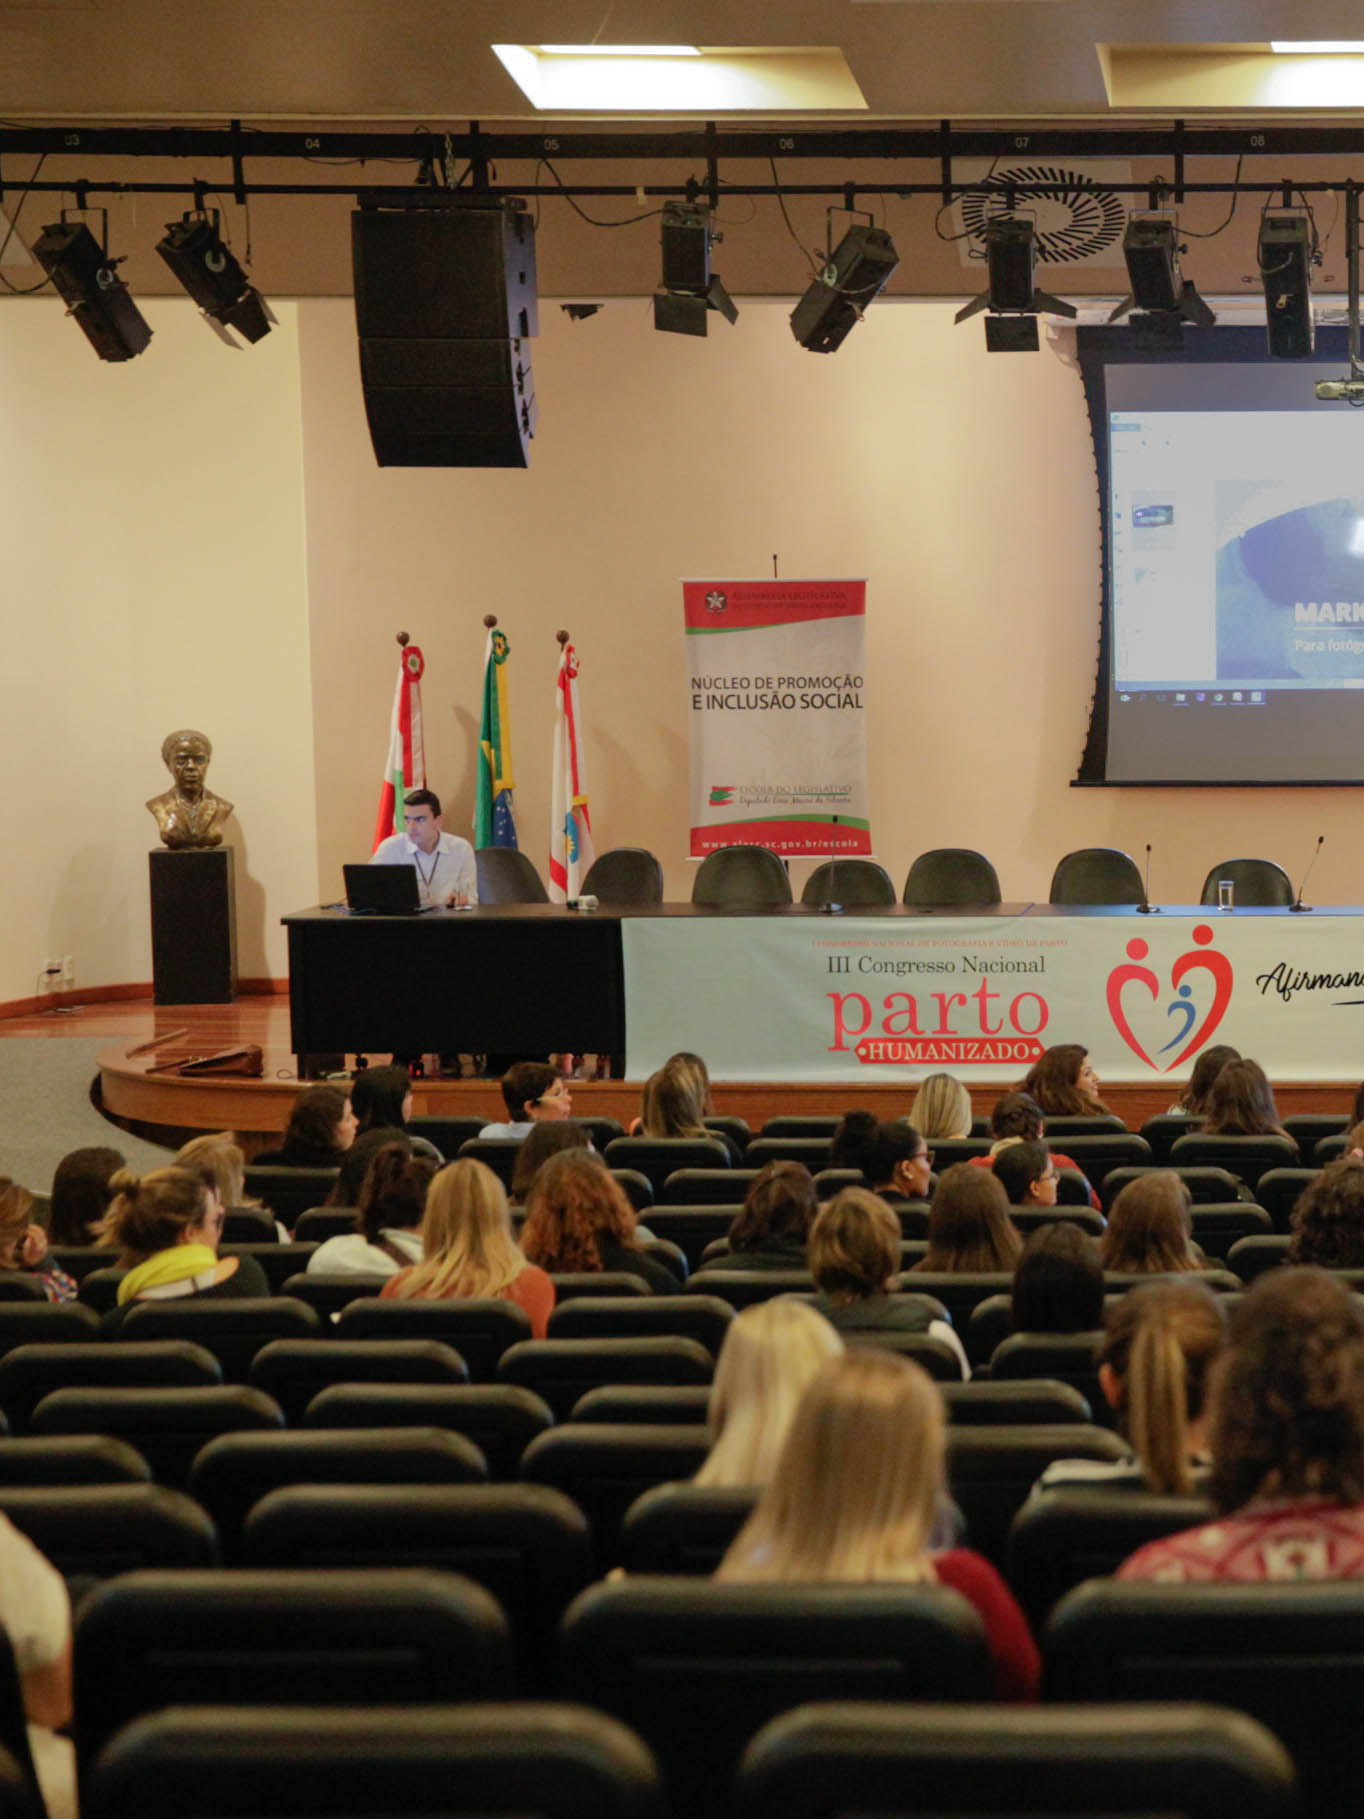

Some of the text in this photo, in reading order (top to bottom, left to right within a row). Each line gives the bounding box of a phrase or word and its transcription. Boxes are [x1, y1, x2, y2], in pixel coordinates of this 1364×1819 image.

[305, 138, 321, 149] 04
[544, 139, 560, 150] 05
[779, 138, 795, 149] 06
[1015, 137, 1029, 148] 07
[1250, 135, 1266, 147] 08
[1295, 638, 1325, 651] Para
[692, 674, 864, 692] NÚCLEO DE PROMOÇÃO
[692, 691, 864, 710] E INCLUSÃO SOCIAL
[828, 955, 1046, 978] III Congresso Nacional
[826, 977, 1050, 1052] parto
[868, 1042, 1030, 1061] HUMANIZADO
